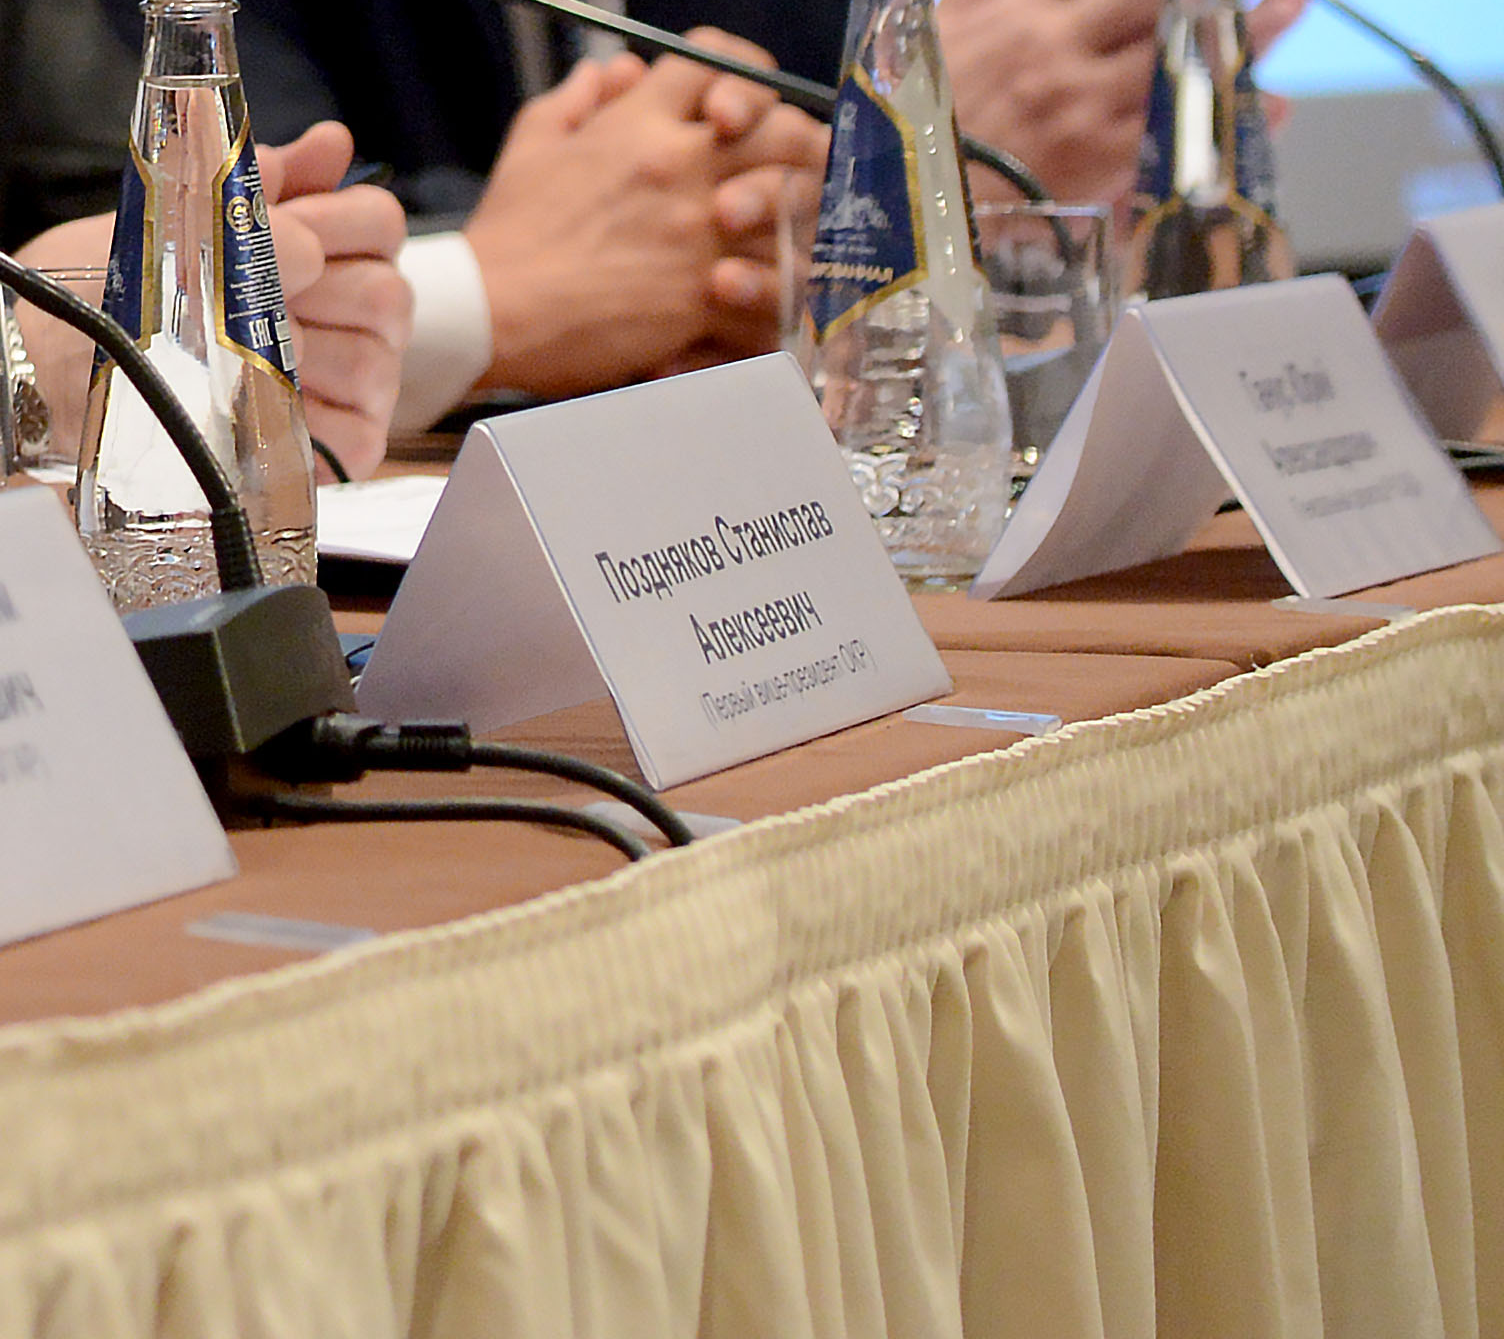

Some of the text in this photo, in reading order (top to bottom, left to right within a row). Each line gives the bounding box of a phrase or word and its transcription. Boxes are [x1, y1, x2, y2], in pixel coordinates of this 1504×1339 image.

[595, 500, 834, 605] Поздняков Станислав
[689, 590, 824, 665] Алексеевич
